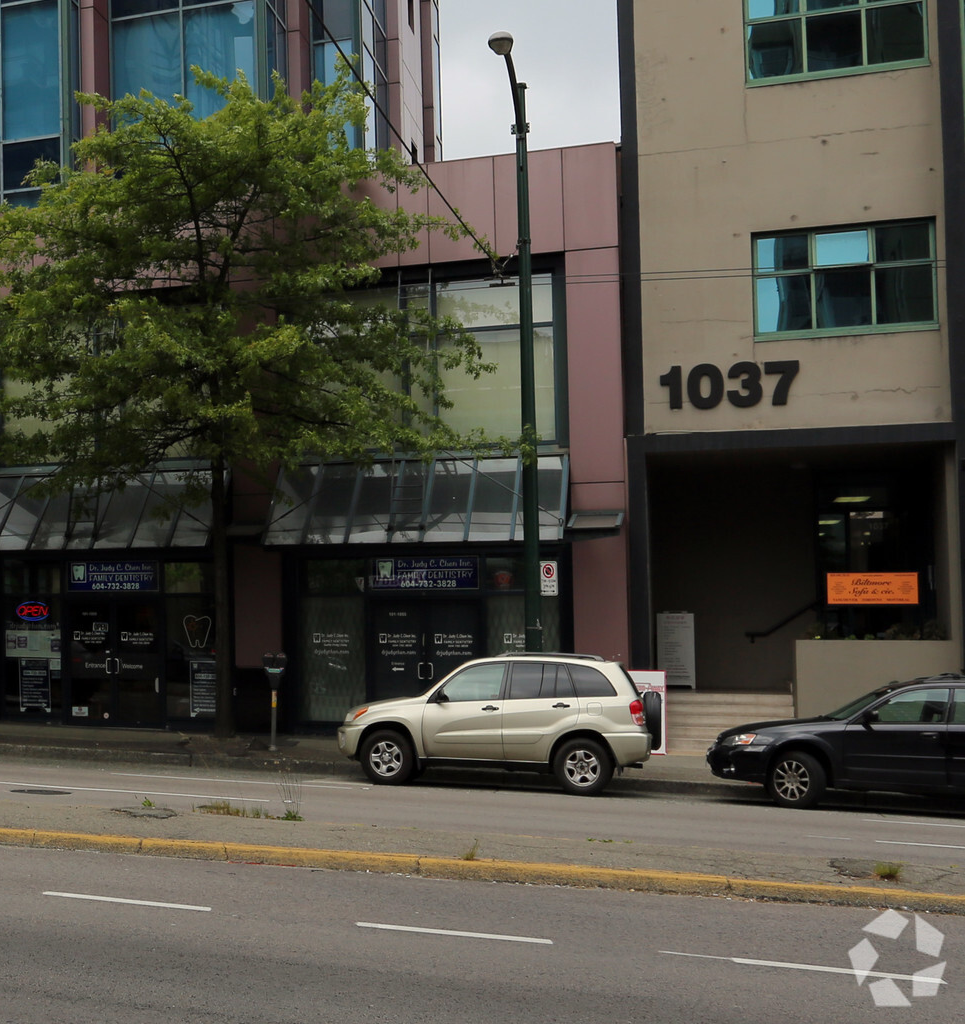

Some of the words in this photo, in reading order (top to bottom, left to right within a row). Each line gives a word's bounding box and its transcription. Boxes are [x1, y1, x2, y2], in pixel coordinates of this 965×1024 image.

[659, 359, 800, 410] 1037
[89, 563, 99, 572] Dr.
[101, 563, 115, 573] Judy
[124, 563, 141, 572] Chen
[142, 563, 154, 571] Inc.
[397, 559, 409, 568] Dr.
[411, 559, 427, 569] Judy
[429, 559, 437, 568] C.
[439, 559, 458, 568] Chen
[459, 559, 473, 567] Inc.
[89, 574, 113, 582] FAMILY
[115, 574, 153, 582] DENTISTRY
[397, 571, 426, 579] FAMILY
[427, 571, 473, 579] DENTISTRY
[92, 582, 140, 590] 604-732-3828
[400, 579, 456, 588] 604-732-3828
[850, 578, 892, 586] Biltmore
[17, 604, 50, 617] OPEN
